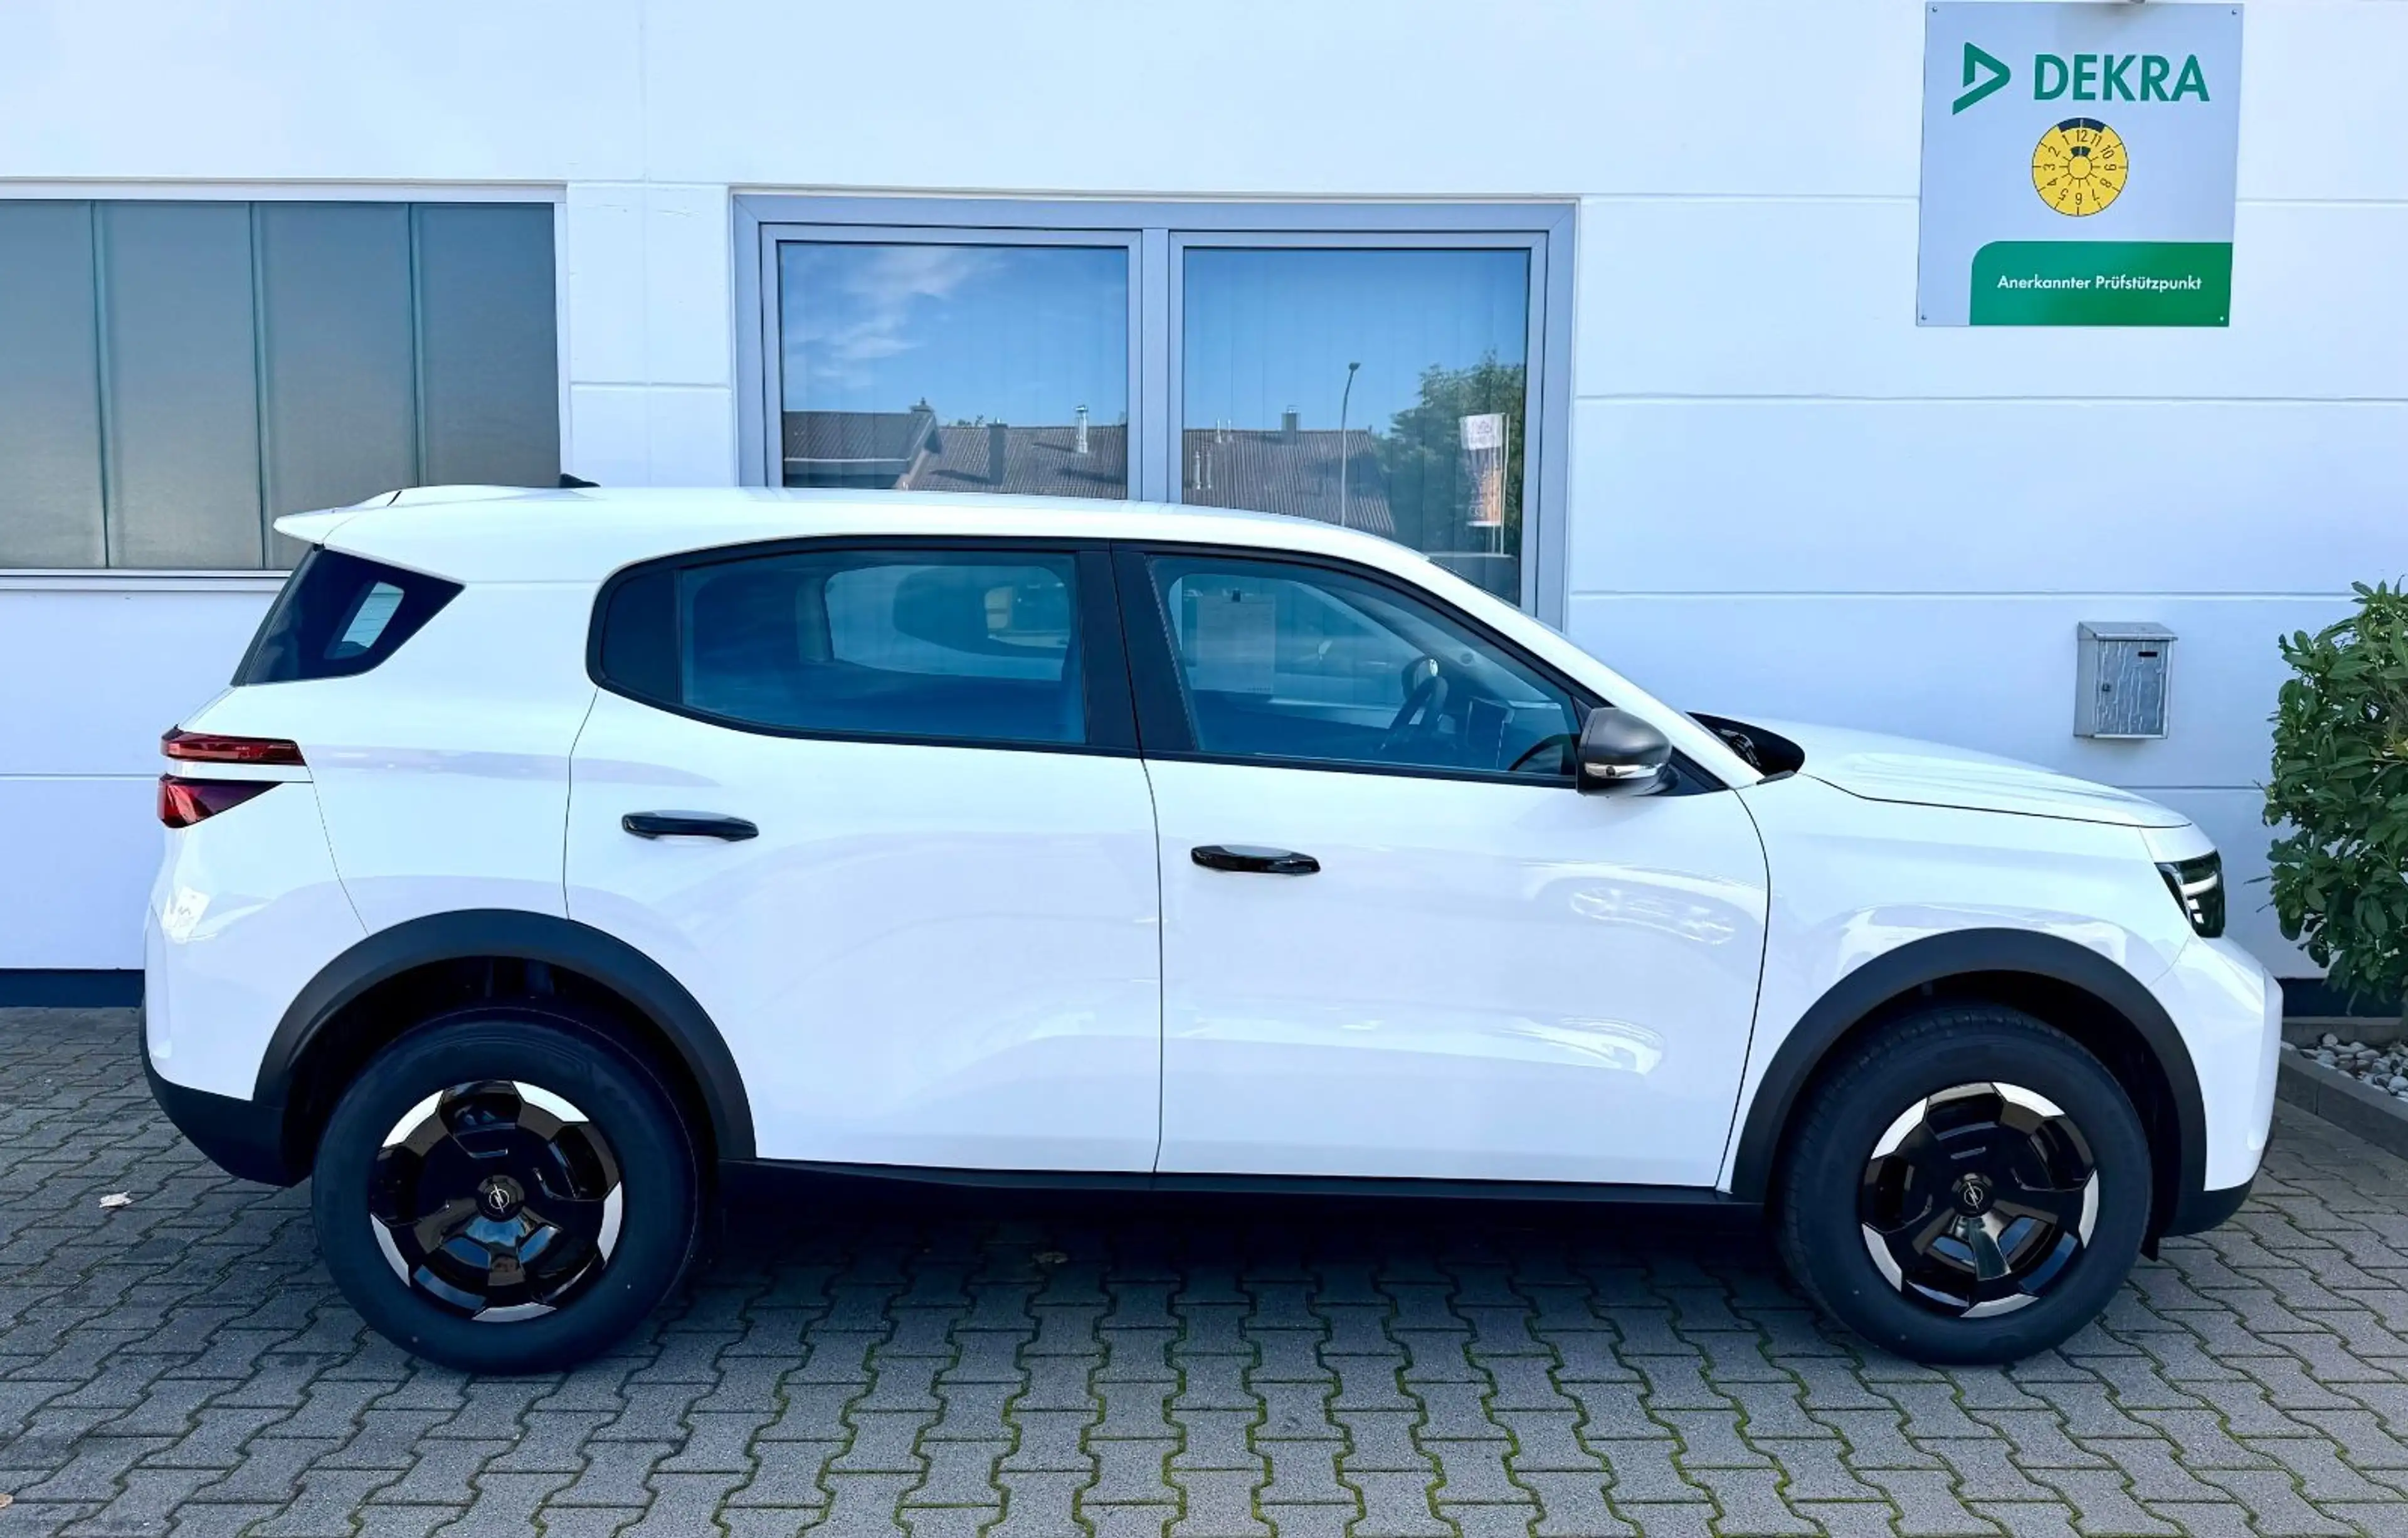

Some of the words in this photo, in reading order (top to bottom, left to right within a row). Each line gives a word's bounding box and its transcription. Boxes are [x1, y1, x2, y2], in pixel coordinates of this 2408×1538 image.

[2034, 54, 2210, 102] DEKRA
[2076, 130, 2088, 142] 12
[2090, 133, 2102, 146] 11
[2048, 146, 2061, 157] 2
[2099, 145, 2115, 159] 10
[2042, 163, 2056, 171] 3
[2099, 178, 2112, 188] 8
[2059, 188, 2069, 201] 5
[1997, 275, 2091, 289] Anerkannter
[2096, 274, 2202, 293] Prüfstützpunkt
